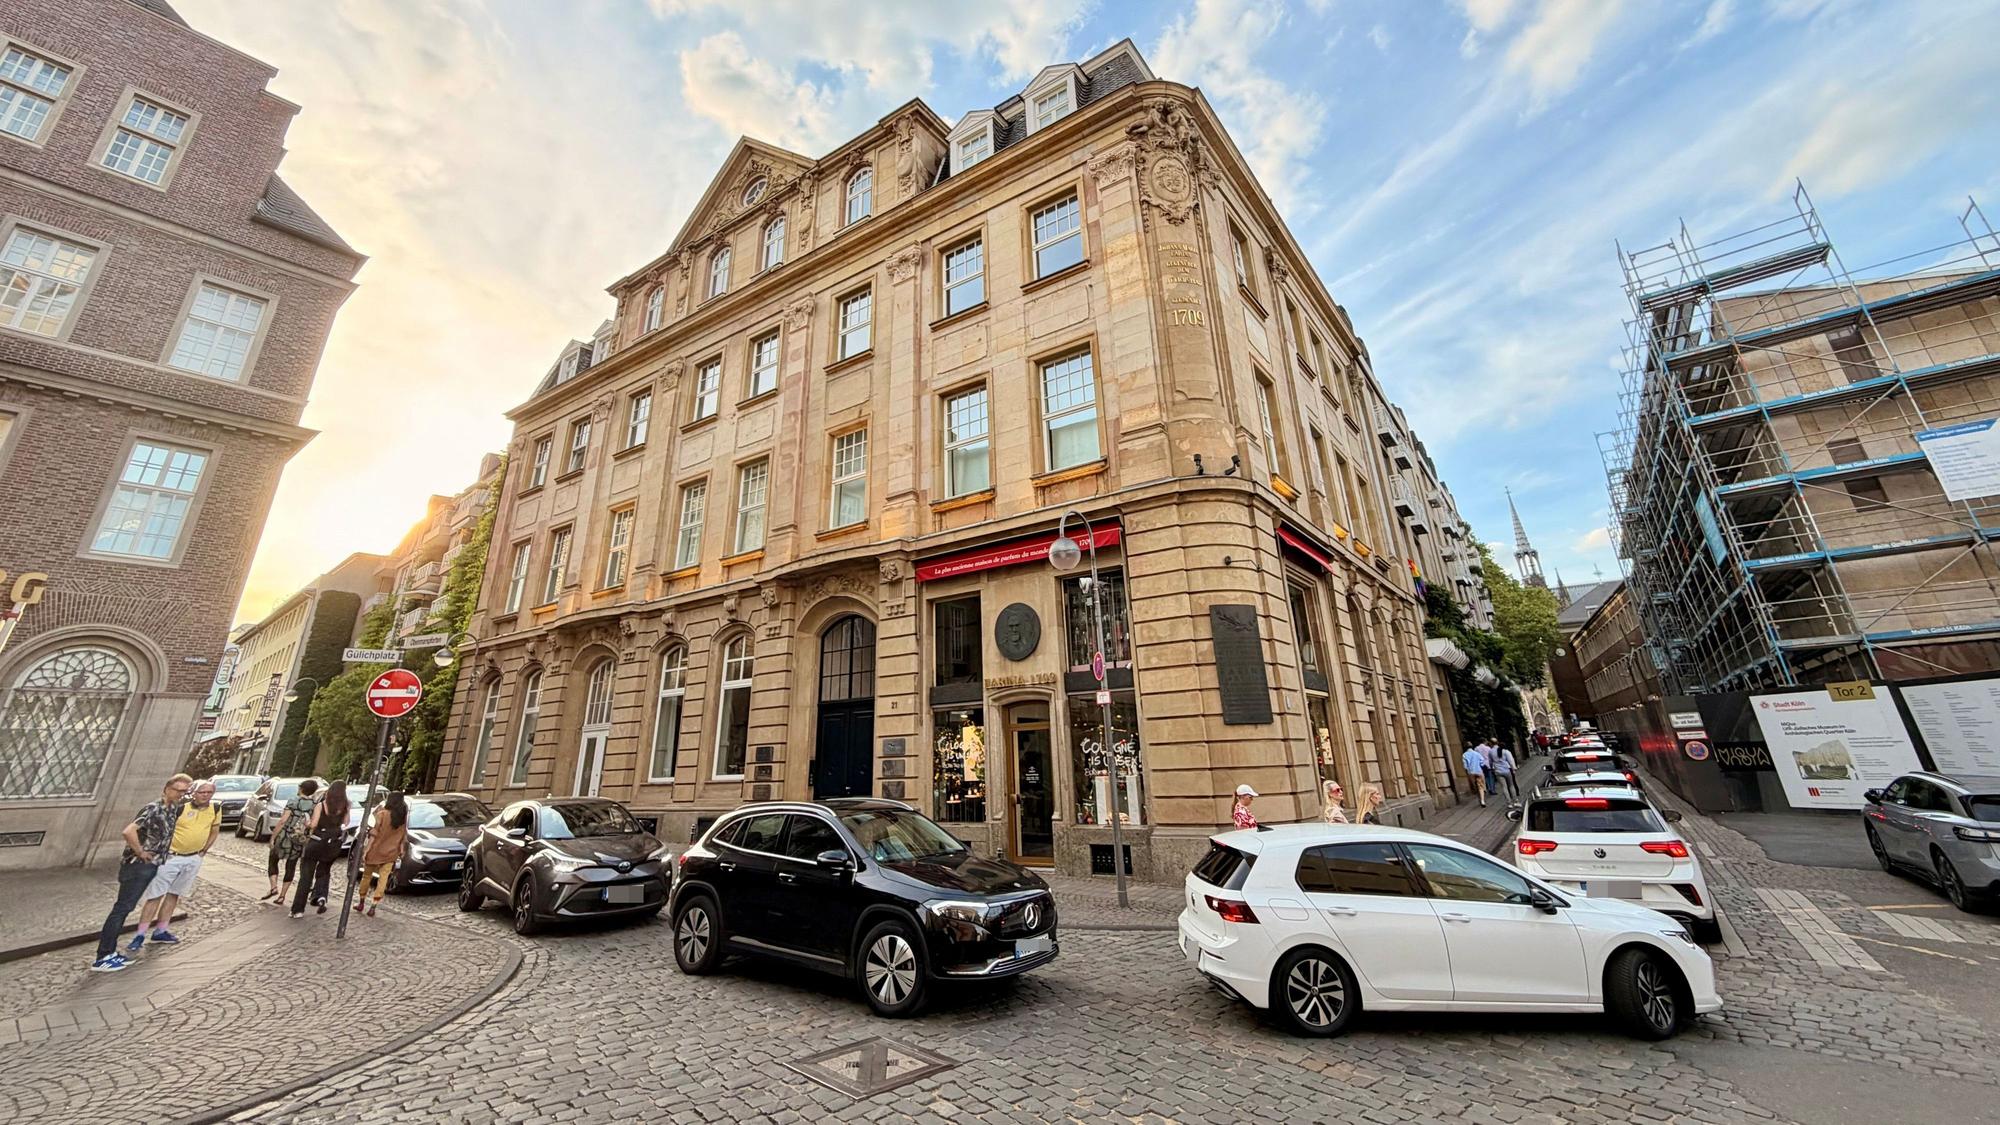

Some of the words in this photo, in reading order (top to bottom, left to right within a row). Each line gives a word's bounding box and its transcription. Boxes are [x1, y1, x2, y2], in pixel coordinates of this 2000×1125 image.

[1171, 308, 1205, 326] 1709
[346, 649, 396, 660] Gülichplatz
[1834, 686, 1855, 697] Tor
[1859, 685, 1868, 696] 2
[891, 701, 898, 710] 21
[1081, 738, 1136, 755] COLGNE
